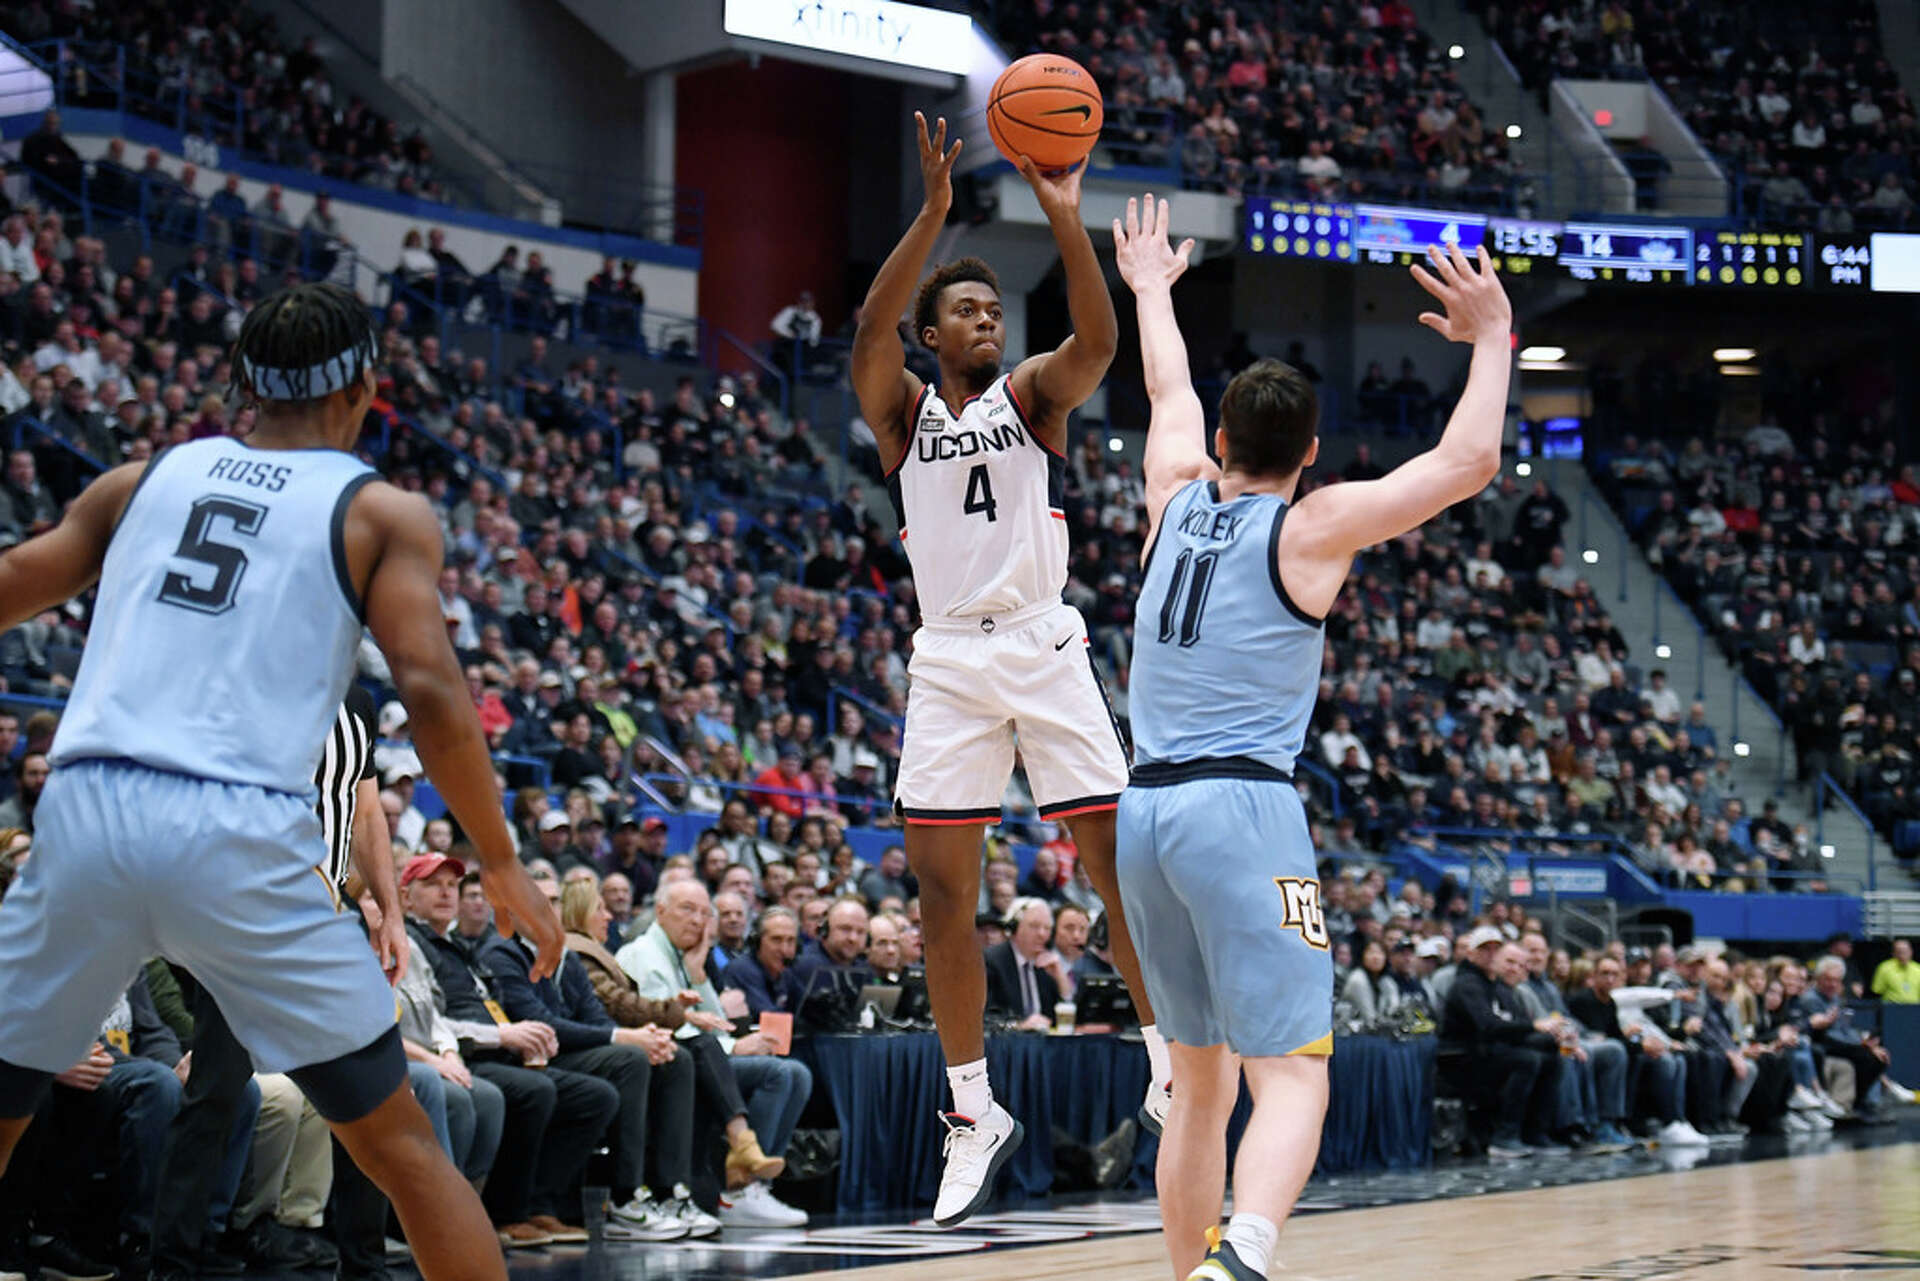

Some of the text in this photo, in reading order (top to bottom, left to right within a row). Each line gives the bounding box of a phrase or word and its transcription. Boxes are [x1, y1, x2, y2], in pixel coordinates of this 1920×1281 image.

[1580, 231, 1613, 258] 14
[918, 423, 1026, 463] UCONN
[208, 457, 292, 492] ROSS
[963, 463, 997, 523] 4
[1178, 509, 1243, 542] KOLEK
[157, 493, 269, 616] 5
[1158, 547, 1219, 648] 11
